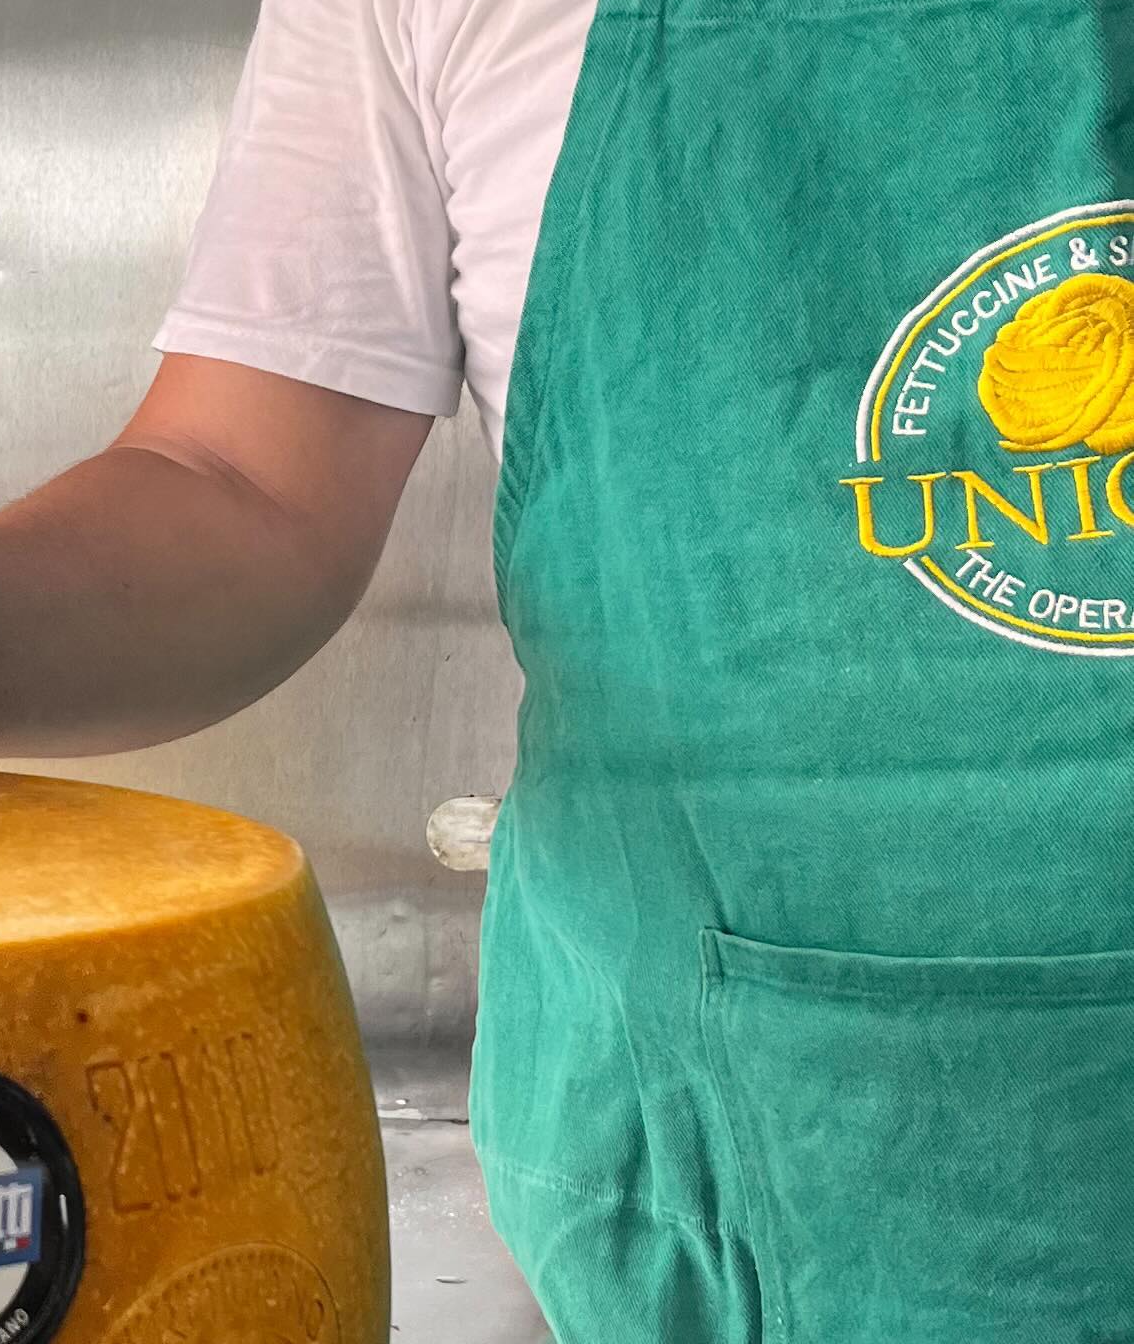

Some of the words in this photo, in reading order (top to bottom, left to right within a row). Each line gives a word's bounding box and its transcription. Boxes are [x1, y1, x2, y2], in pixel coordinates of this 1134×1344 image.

[892, 253, 1057, 436] FETTUCCINE
[1068, 237, 1100, 271] &
[1109, 235, 1134, 268] S
[955, 549, 1025, 608] THE
[1028, 588, 1134, 629] OPER
